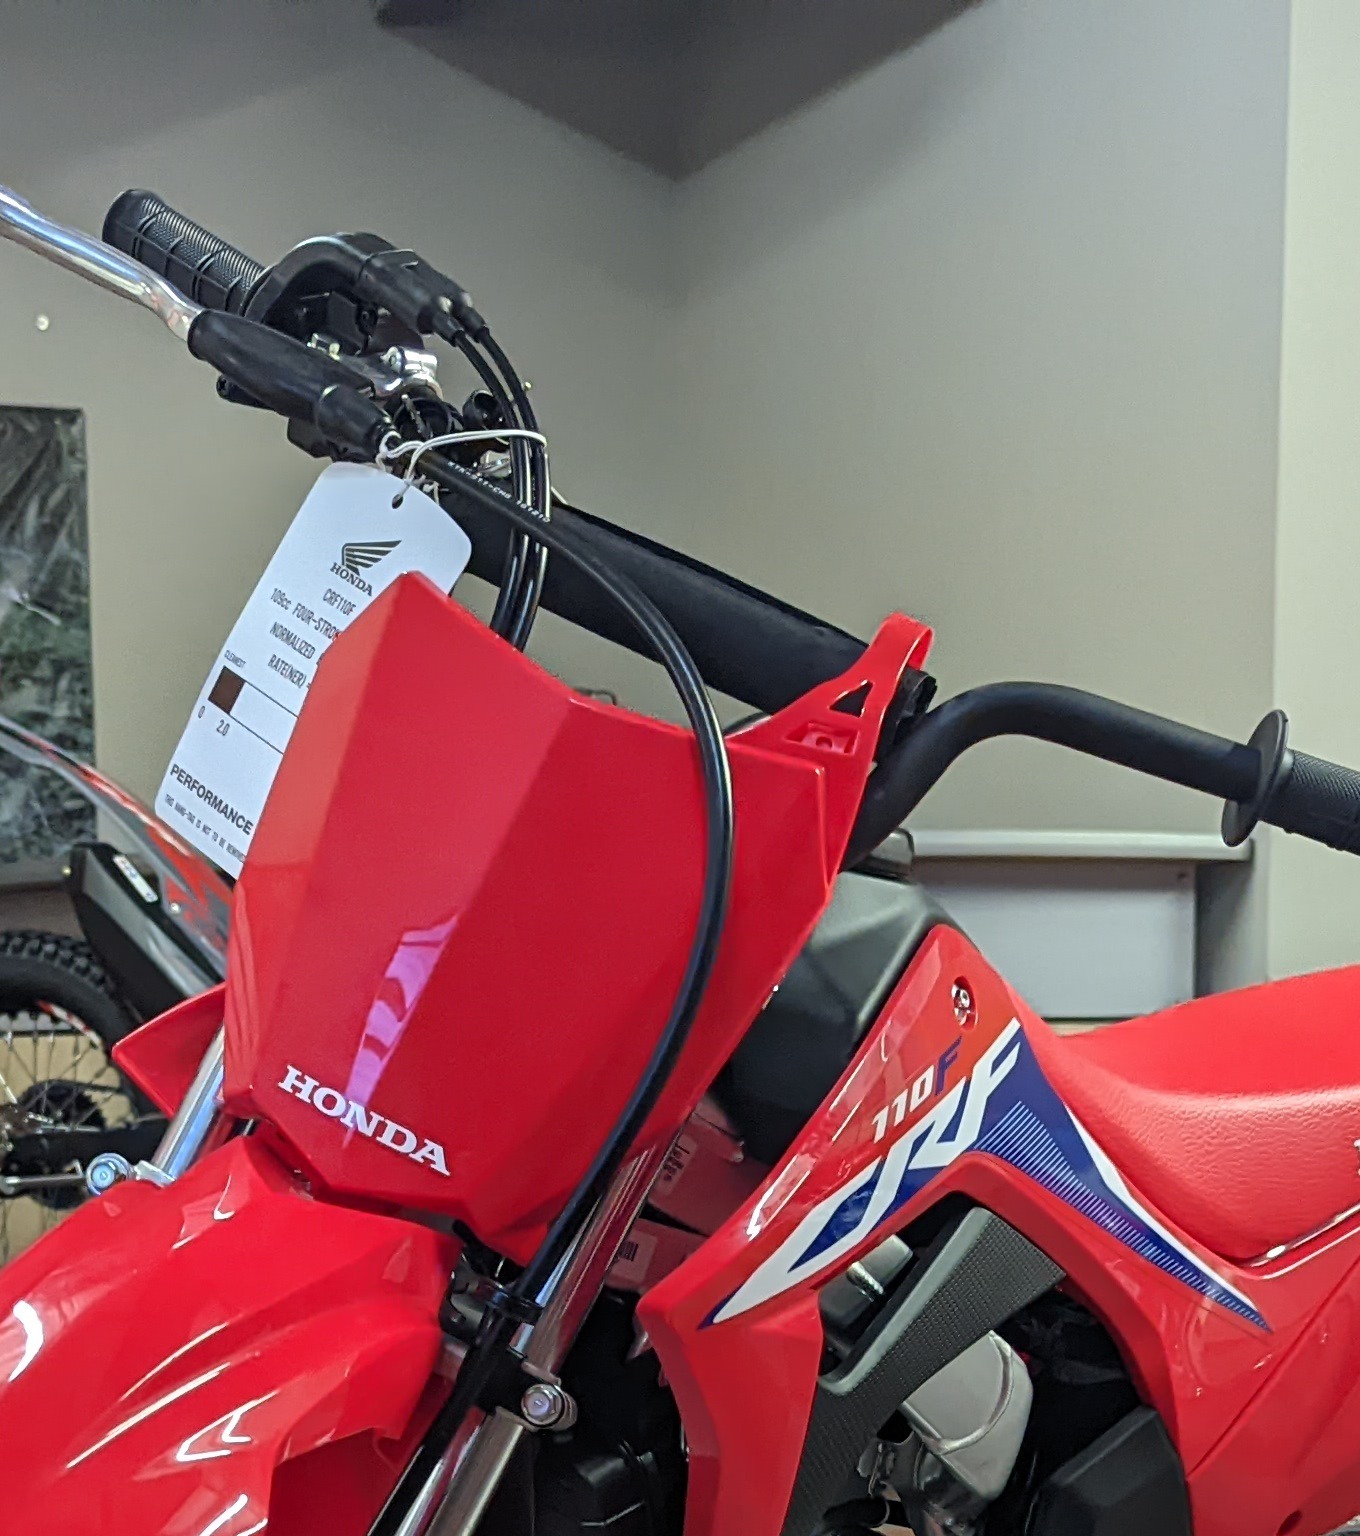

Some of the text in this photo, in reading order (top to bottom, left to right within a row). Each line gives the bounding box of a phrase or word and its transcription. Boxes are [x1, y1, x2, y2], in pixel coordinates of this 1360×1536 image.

[323, 588, 357, 616] CRF110F
[329, 561, 373, 597] HONDA
[269, 621, 316, 660] NORMALIZED
[170, 763, 254, 836] PERFORMANCE
[277, 1064, 451, 1177] HONDA
[871, 1035, 963, 1144] 110F
[712, 1017, 1022, 1324] CRF
